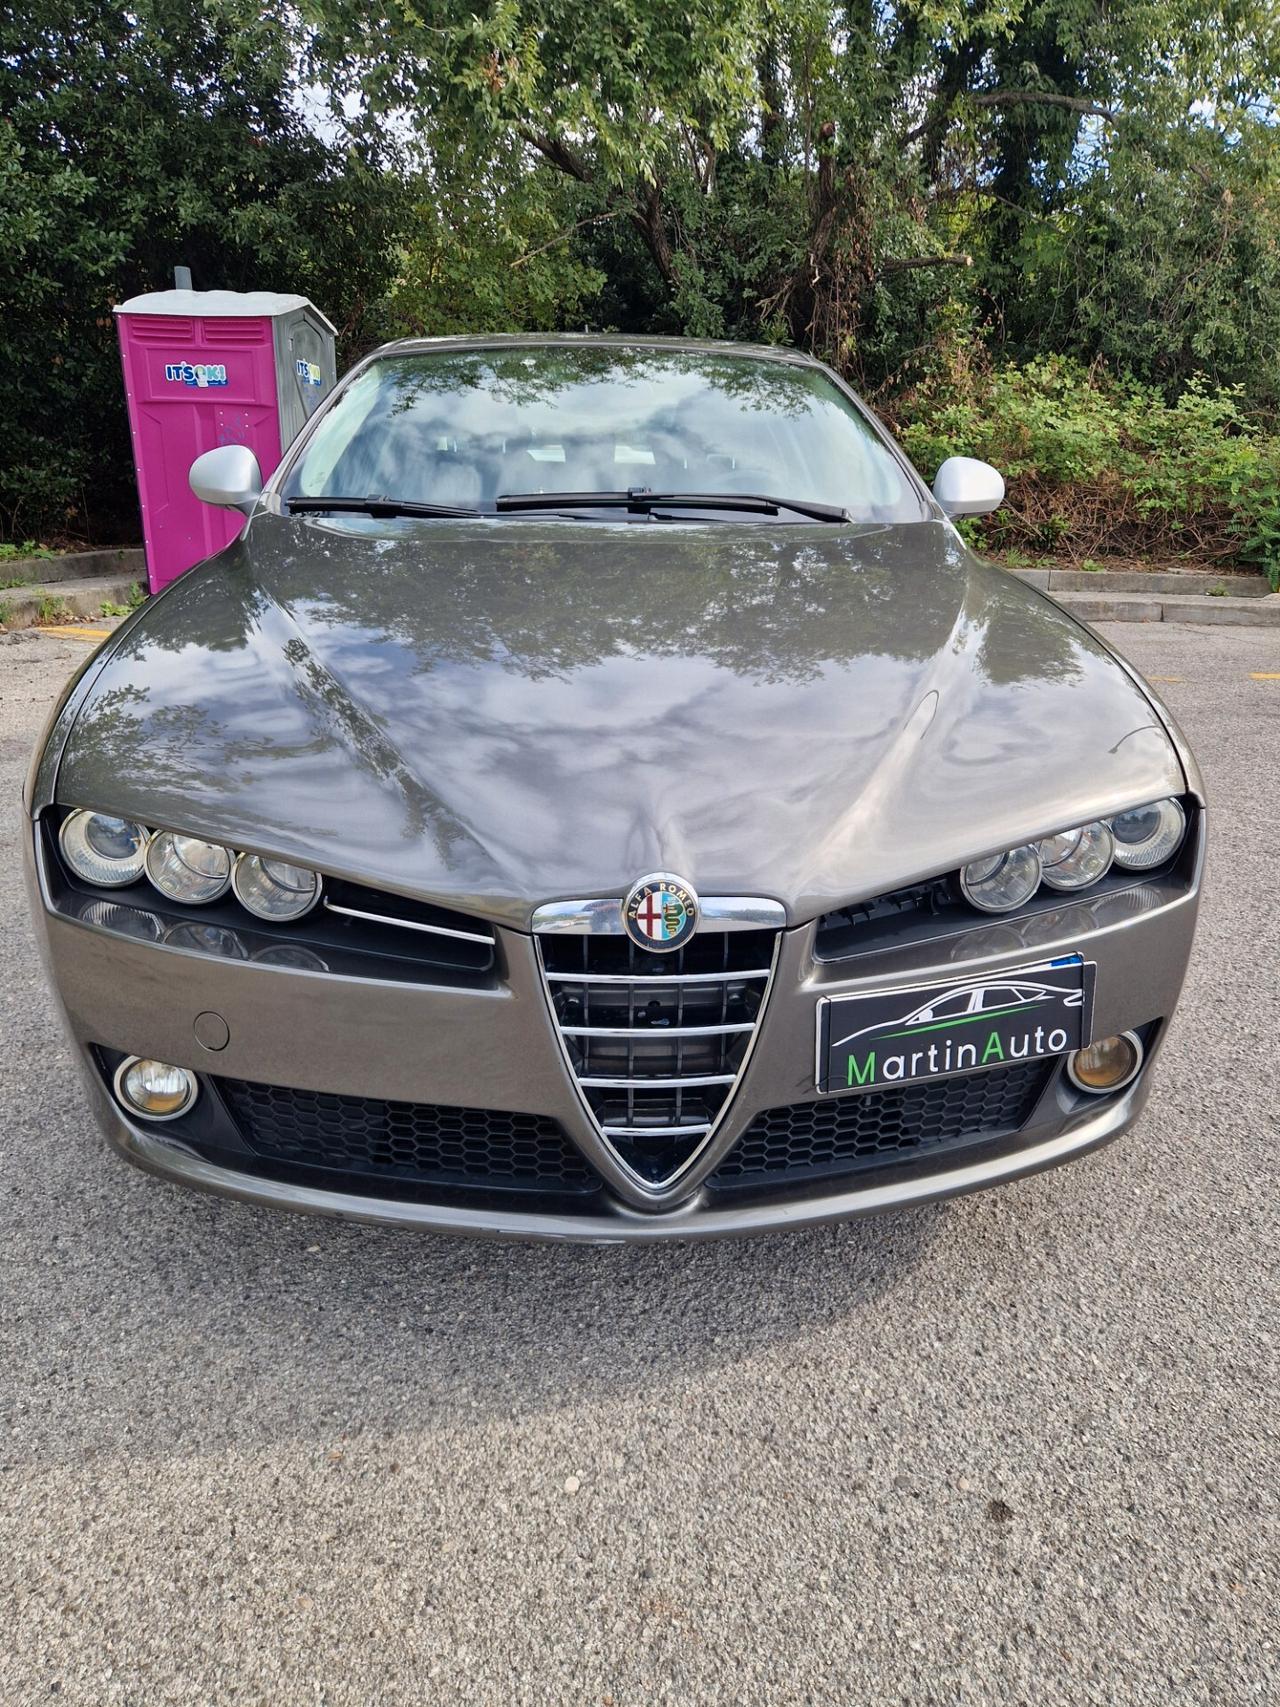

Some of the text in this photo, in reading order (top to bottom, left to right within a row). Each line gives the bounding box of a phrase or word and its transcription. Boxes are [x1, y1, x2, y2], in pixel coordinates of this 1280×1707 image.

[628, 883, 695, 919] ALFA ROMEO
[847, 1026, 1068, 1088] MartinAuto
